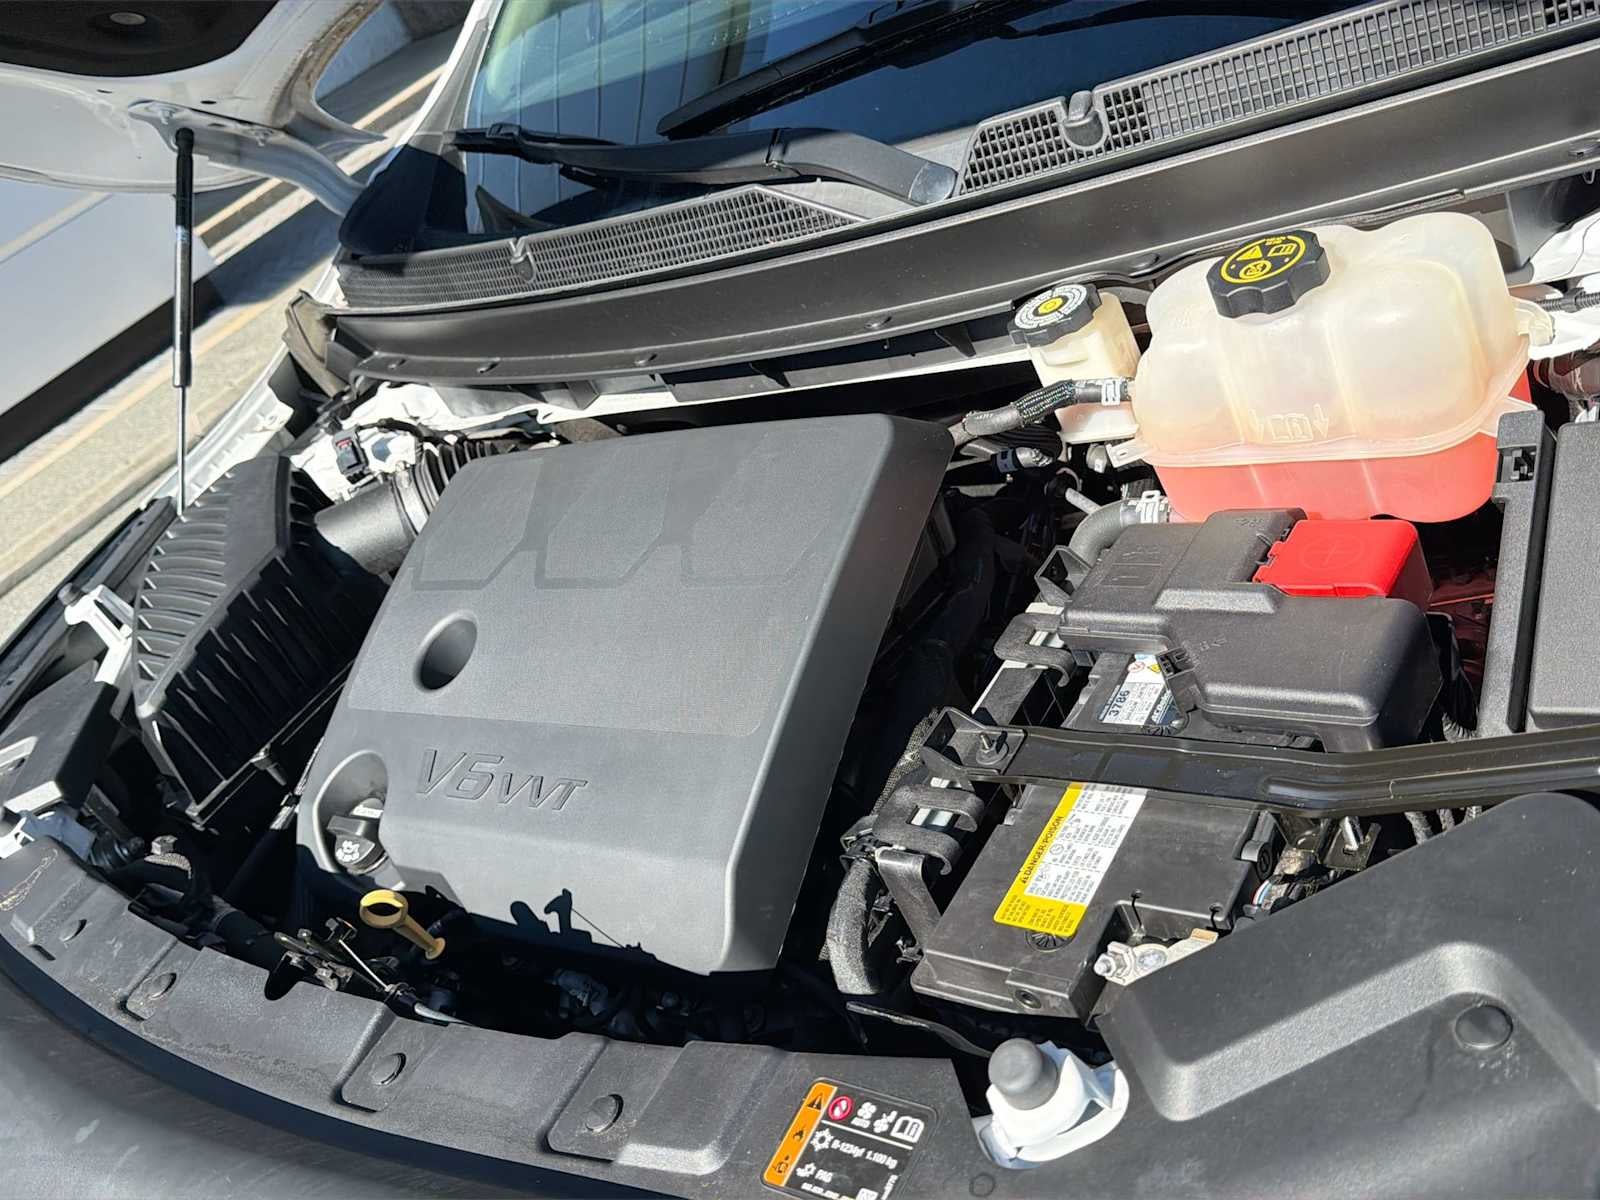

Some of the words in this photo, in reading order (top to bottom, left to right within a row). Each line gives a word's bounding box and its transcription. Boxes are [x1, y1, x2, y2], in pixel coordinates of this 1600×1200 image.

[1108, 690, 1130, 717] 3786
[416, 747, 505, 801] V6
[497, 771, 589, 812] VVT
